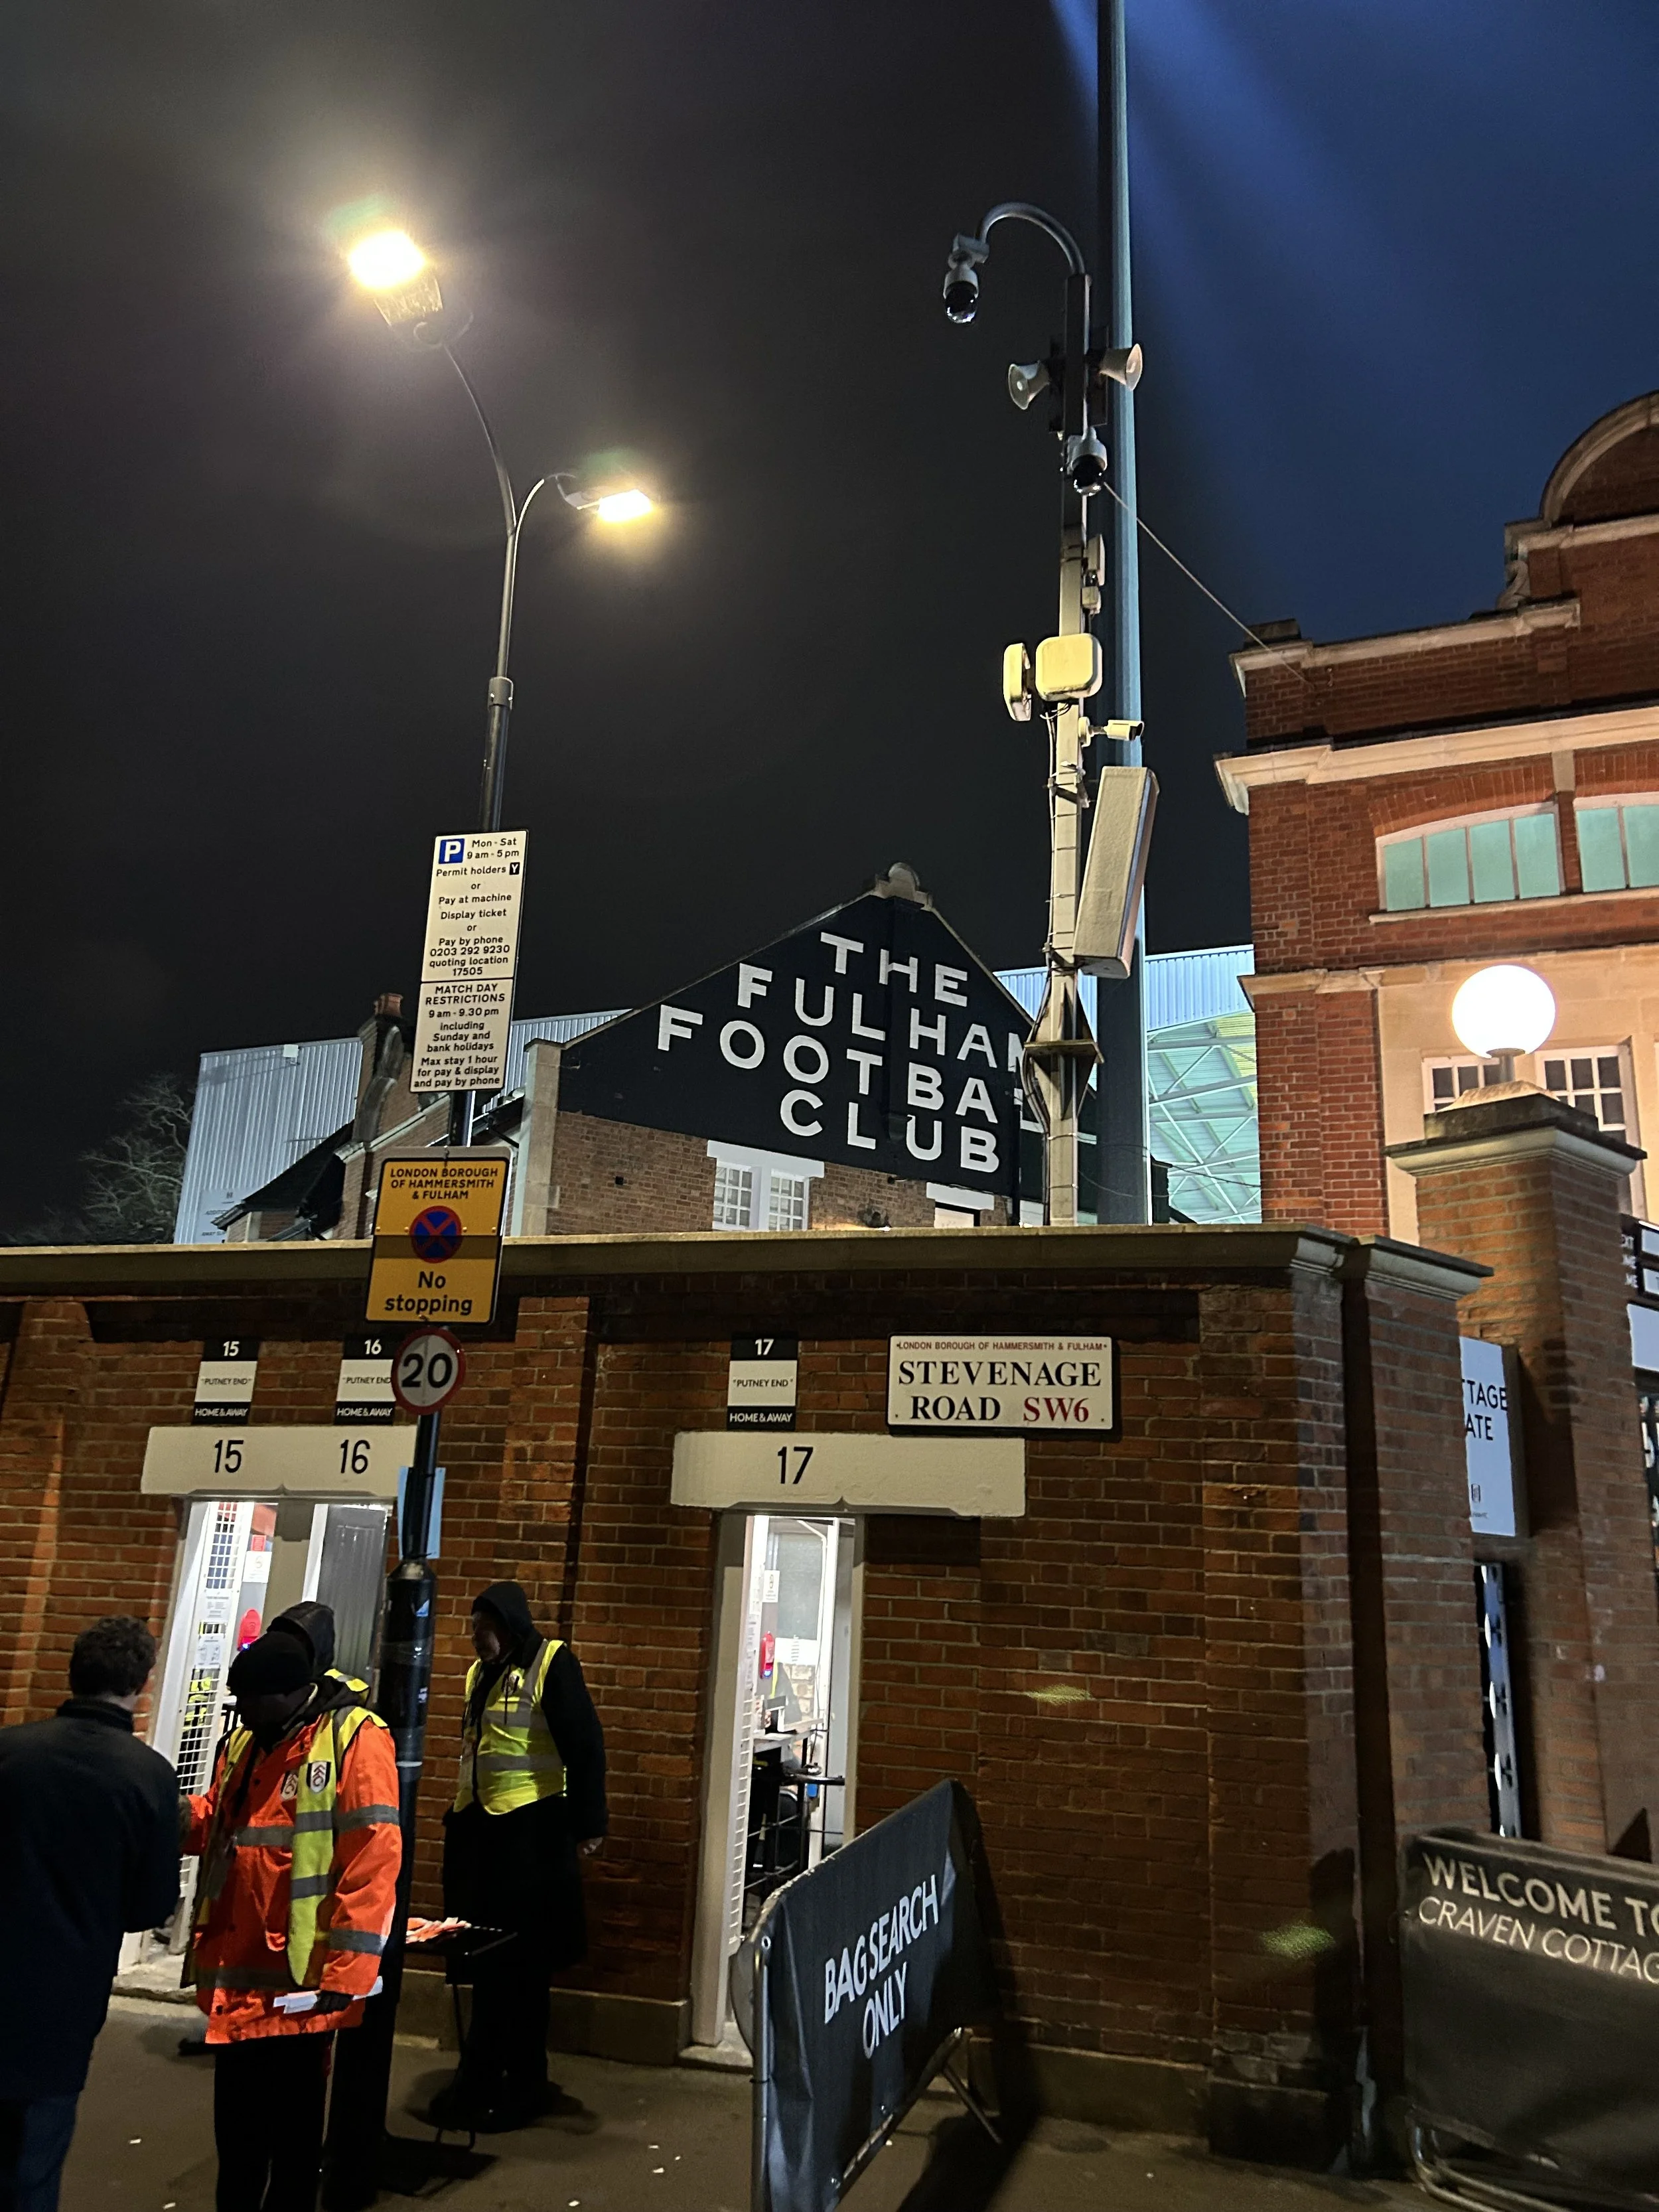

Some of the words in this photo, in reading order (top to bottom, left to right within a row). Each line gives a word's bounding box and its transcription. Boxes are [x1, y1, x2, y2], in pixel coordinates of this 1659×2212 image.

[444, 840, 461, 862] P
[436, 868, 468, 877] Permit
[470, 865, 506, 874] holders
[510, 864, 518, 873] Y
[439, 897, 456, 906] Pay
[472, 893, 512, 903] machine
[441, 911, 475, 921] Display
[479, 909, 507, 917] ticket
[439, 938, 456, 947] Pay
[459, 936, 470, 946] by
[473, 935, 504, 945] phone
[430, 947, 457, 957] 0203
[460, 946, 480, 955] 292
[483, 944, 510, 954] 9230
[429, 958, 467, 968] quoting
[469, 956, 508, 965] location
[453, 967, 483, 976] 17505
[820, 932, 968, 1007] THE
[435, 985, 472, 994] MATCH
[476, 983, 498, 992] DAY
[425, 994, 505, 1005] RESTRICTIONS
[459, 1007, 482, 1017] 9.30
[440, 1021, 484, 1031] including
[433, 1032, 469, 1041] Sunday
[472, 1031, 490, 1039] and
[427, 1044, 451, 1053] bank
[453, 1042, 494, 1051] holidays
[421, 1057, 444, 1066] Max
[444, 1057, 465, 1065] stay
[417, 1068, 431, 1076] for
[434, 1069, 452, 1078] pay
[455, 1067, 461, 1075] &
[465, 1065, 500, 1075] display
[455, 1077, 467, 1086] by
[470, 1076, 500, 1086] phone
[780, 1089, 999, 1173] CLUB
[390, 1168, 438, 1177] LONDON
[441, 1167, 498, 1177] BOROUGH
[391, 1179, 405, 1189] OF
[408, 1179, 494, 1189] HAMMERSMITH
[423, 1190, 469, 1199] FULHAM
[418, 1271, 446, 1289] No
[384, 1294, 473, 1316] stopping
[223, 1341, 240, 1357] 15
[364, 1339, 382, 1355] 16
[755, 1339, 774, 1355] 17
[401, 1352, 453, 1388] 20
[899, 1361, 1101, 1386] STEVENAGE
[910, 1396, 1001, 1420] ROAD
[1023, 1396, 1089, 1422] SW6
[214, 1439, 244, 1473] 15
[340, 1439, 371, 1474] 16
[777, 1446, 814, 1485] 17
[1423, 1852, 1617, 1930] WELCOME
[1624, 1897, 1659, 1938] T
[1418, 1896, 1535, 1950] CRAVEN
[824, 1935, 867, 2025] BAG
[869, 1874, 938, 1980] SEARCH
[863, 1961, 907, 2059] ONLY
